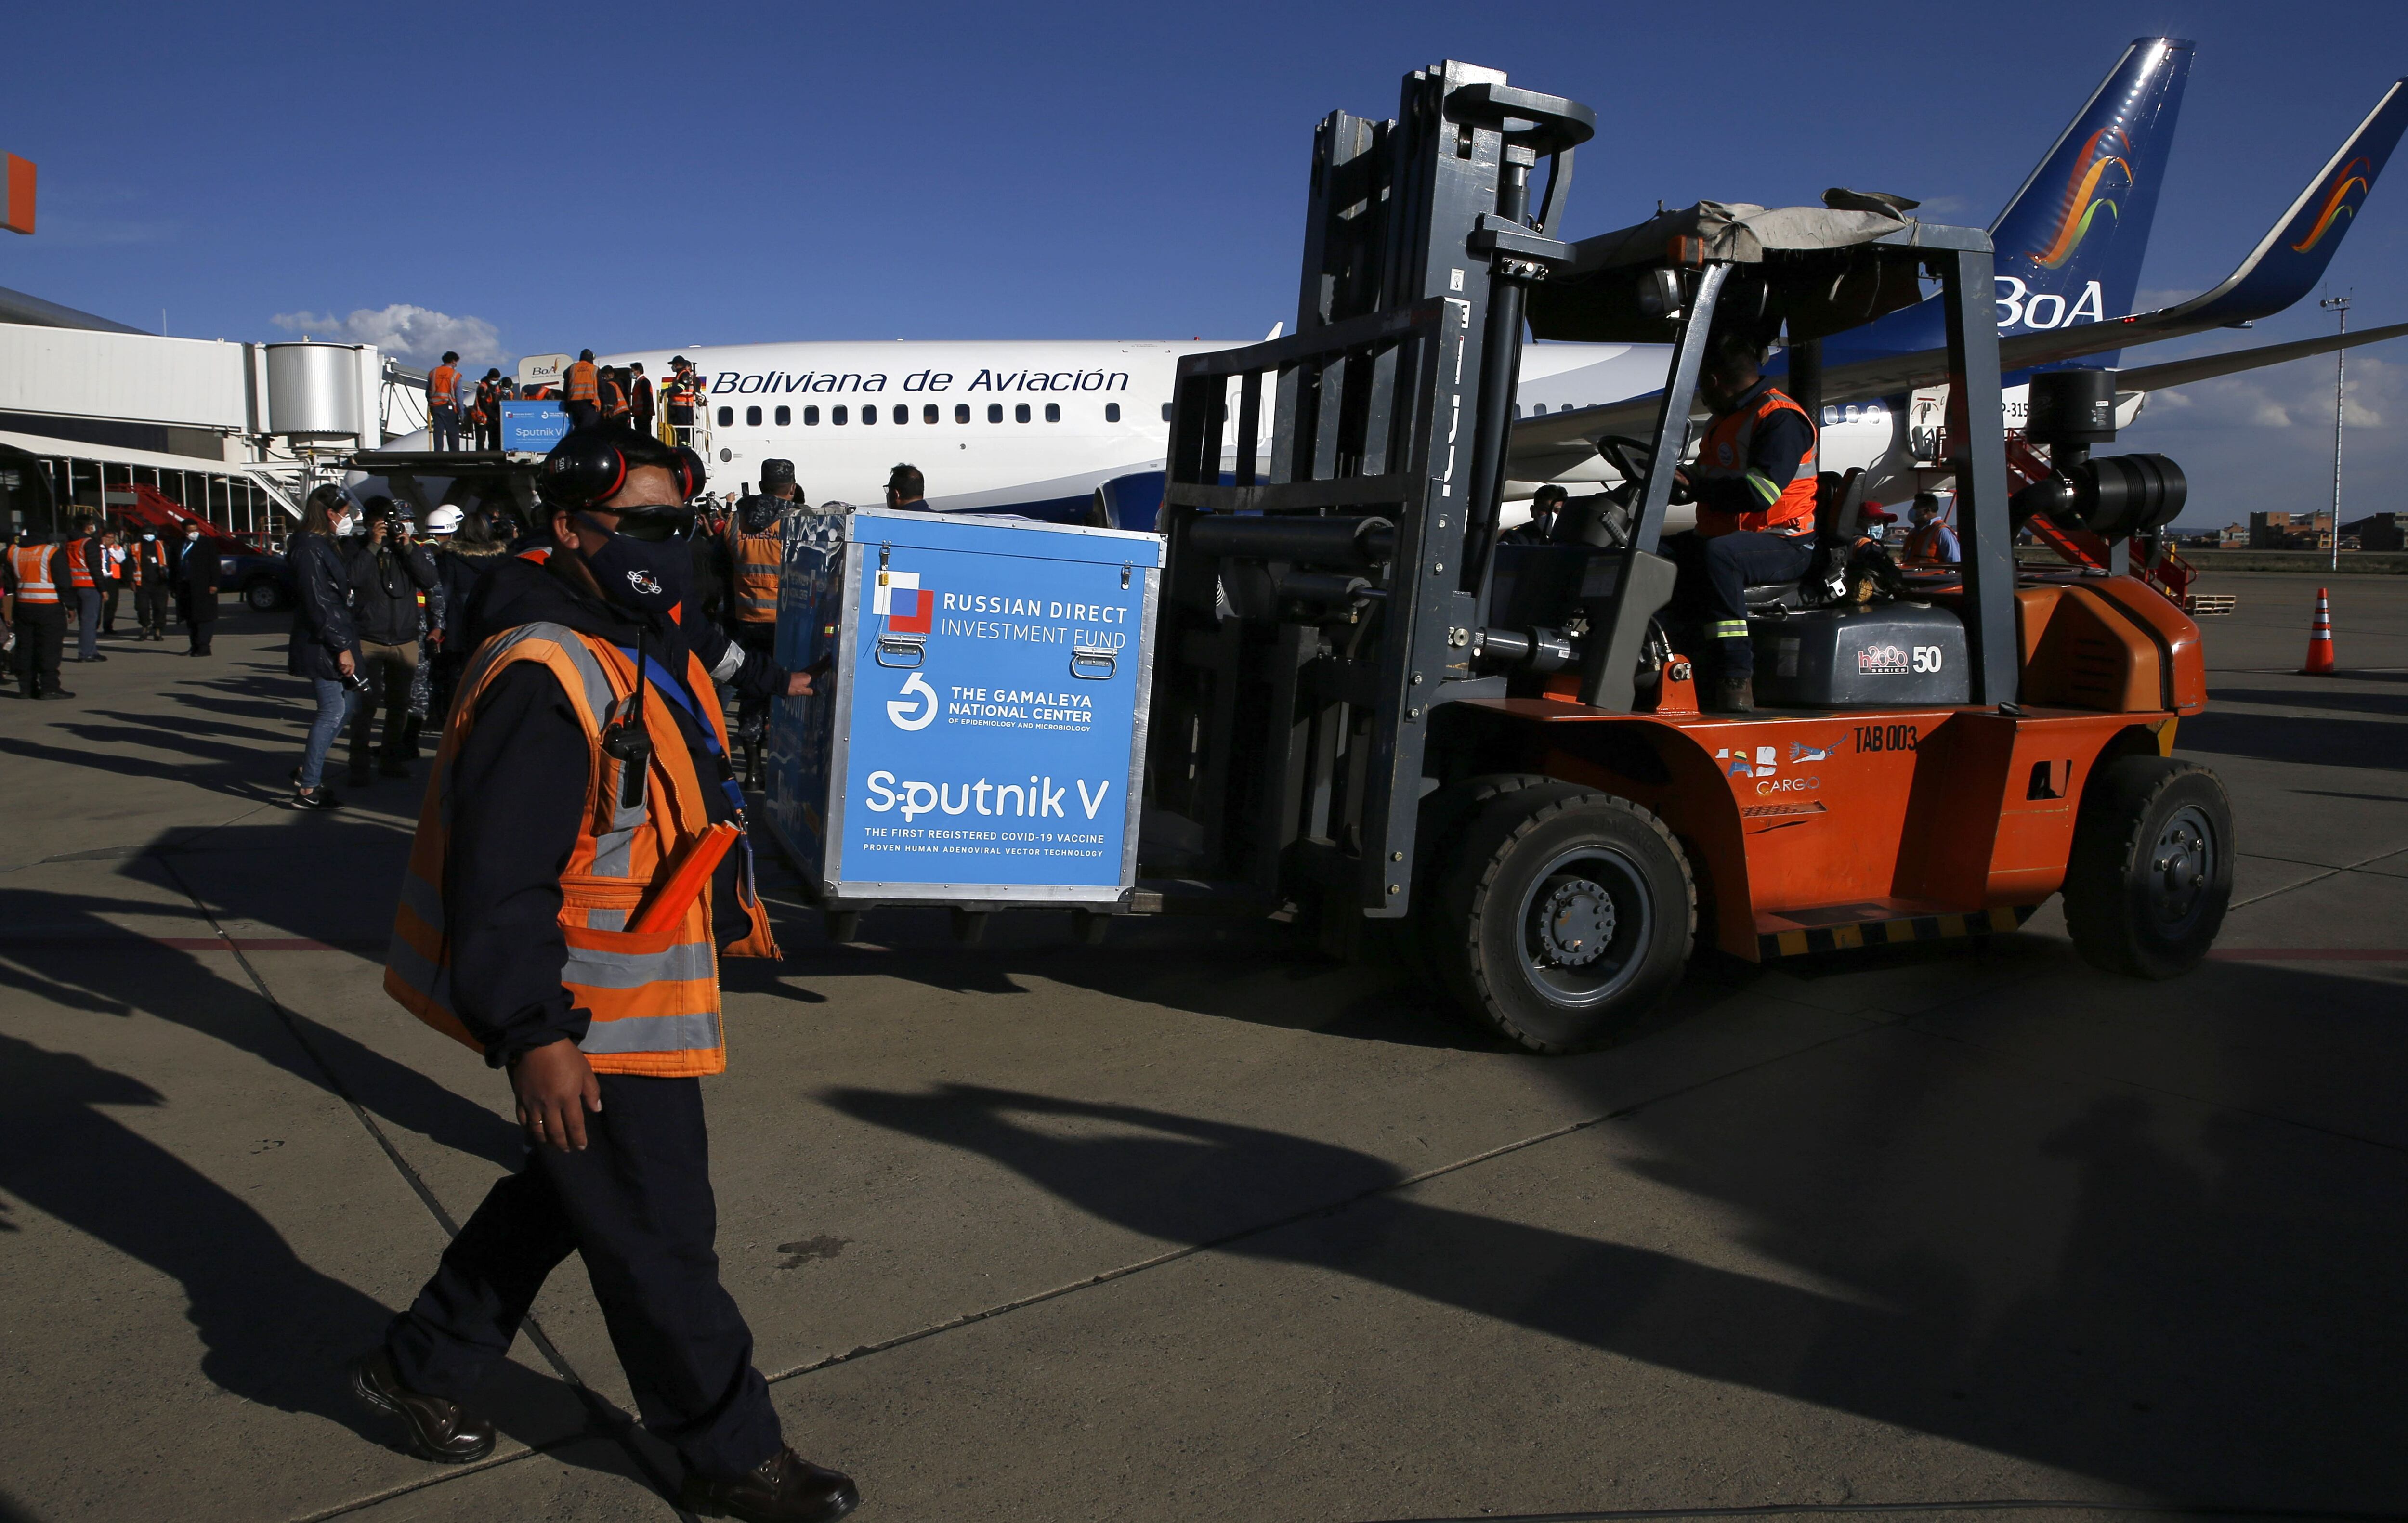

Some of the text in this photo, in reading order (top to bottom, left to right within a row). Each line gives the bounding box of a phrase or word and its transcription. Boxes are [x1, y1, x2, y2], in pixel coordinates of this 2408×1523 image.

[1994, 276, 2104, 329] BoA
[711, 369, 1129, 394] Boliviana de Aviación
[943, 593, 1127, 624] RUSSIAN DIRECT
[942, 618, 1125, 649] INVESTMENT FUND
[1913, 646, 1942, 673] 50
[951, 686, 1092, 708] THE GAMALEYA
[949, 703, 1092, 723] NATIONAL CENTER
[961, 718, 1016, 727] EPIDEMIOLOGY
[1035, 723, 1091, 732] MICROBIOLOGY
[1854, 725, 1917, 754] TAB 003
[1756, 776, 1820, 794] CARGO
[1077, 779, 1109, 820] V
[864, 828, 1104, 843] THE FIRST REGISTERED COVID-19 VACCINE
